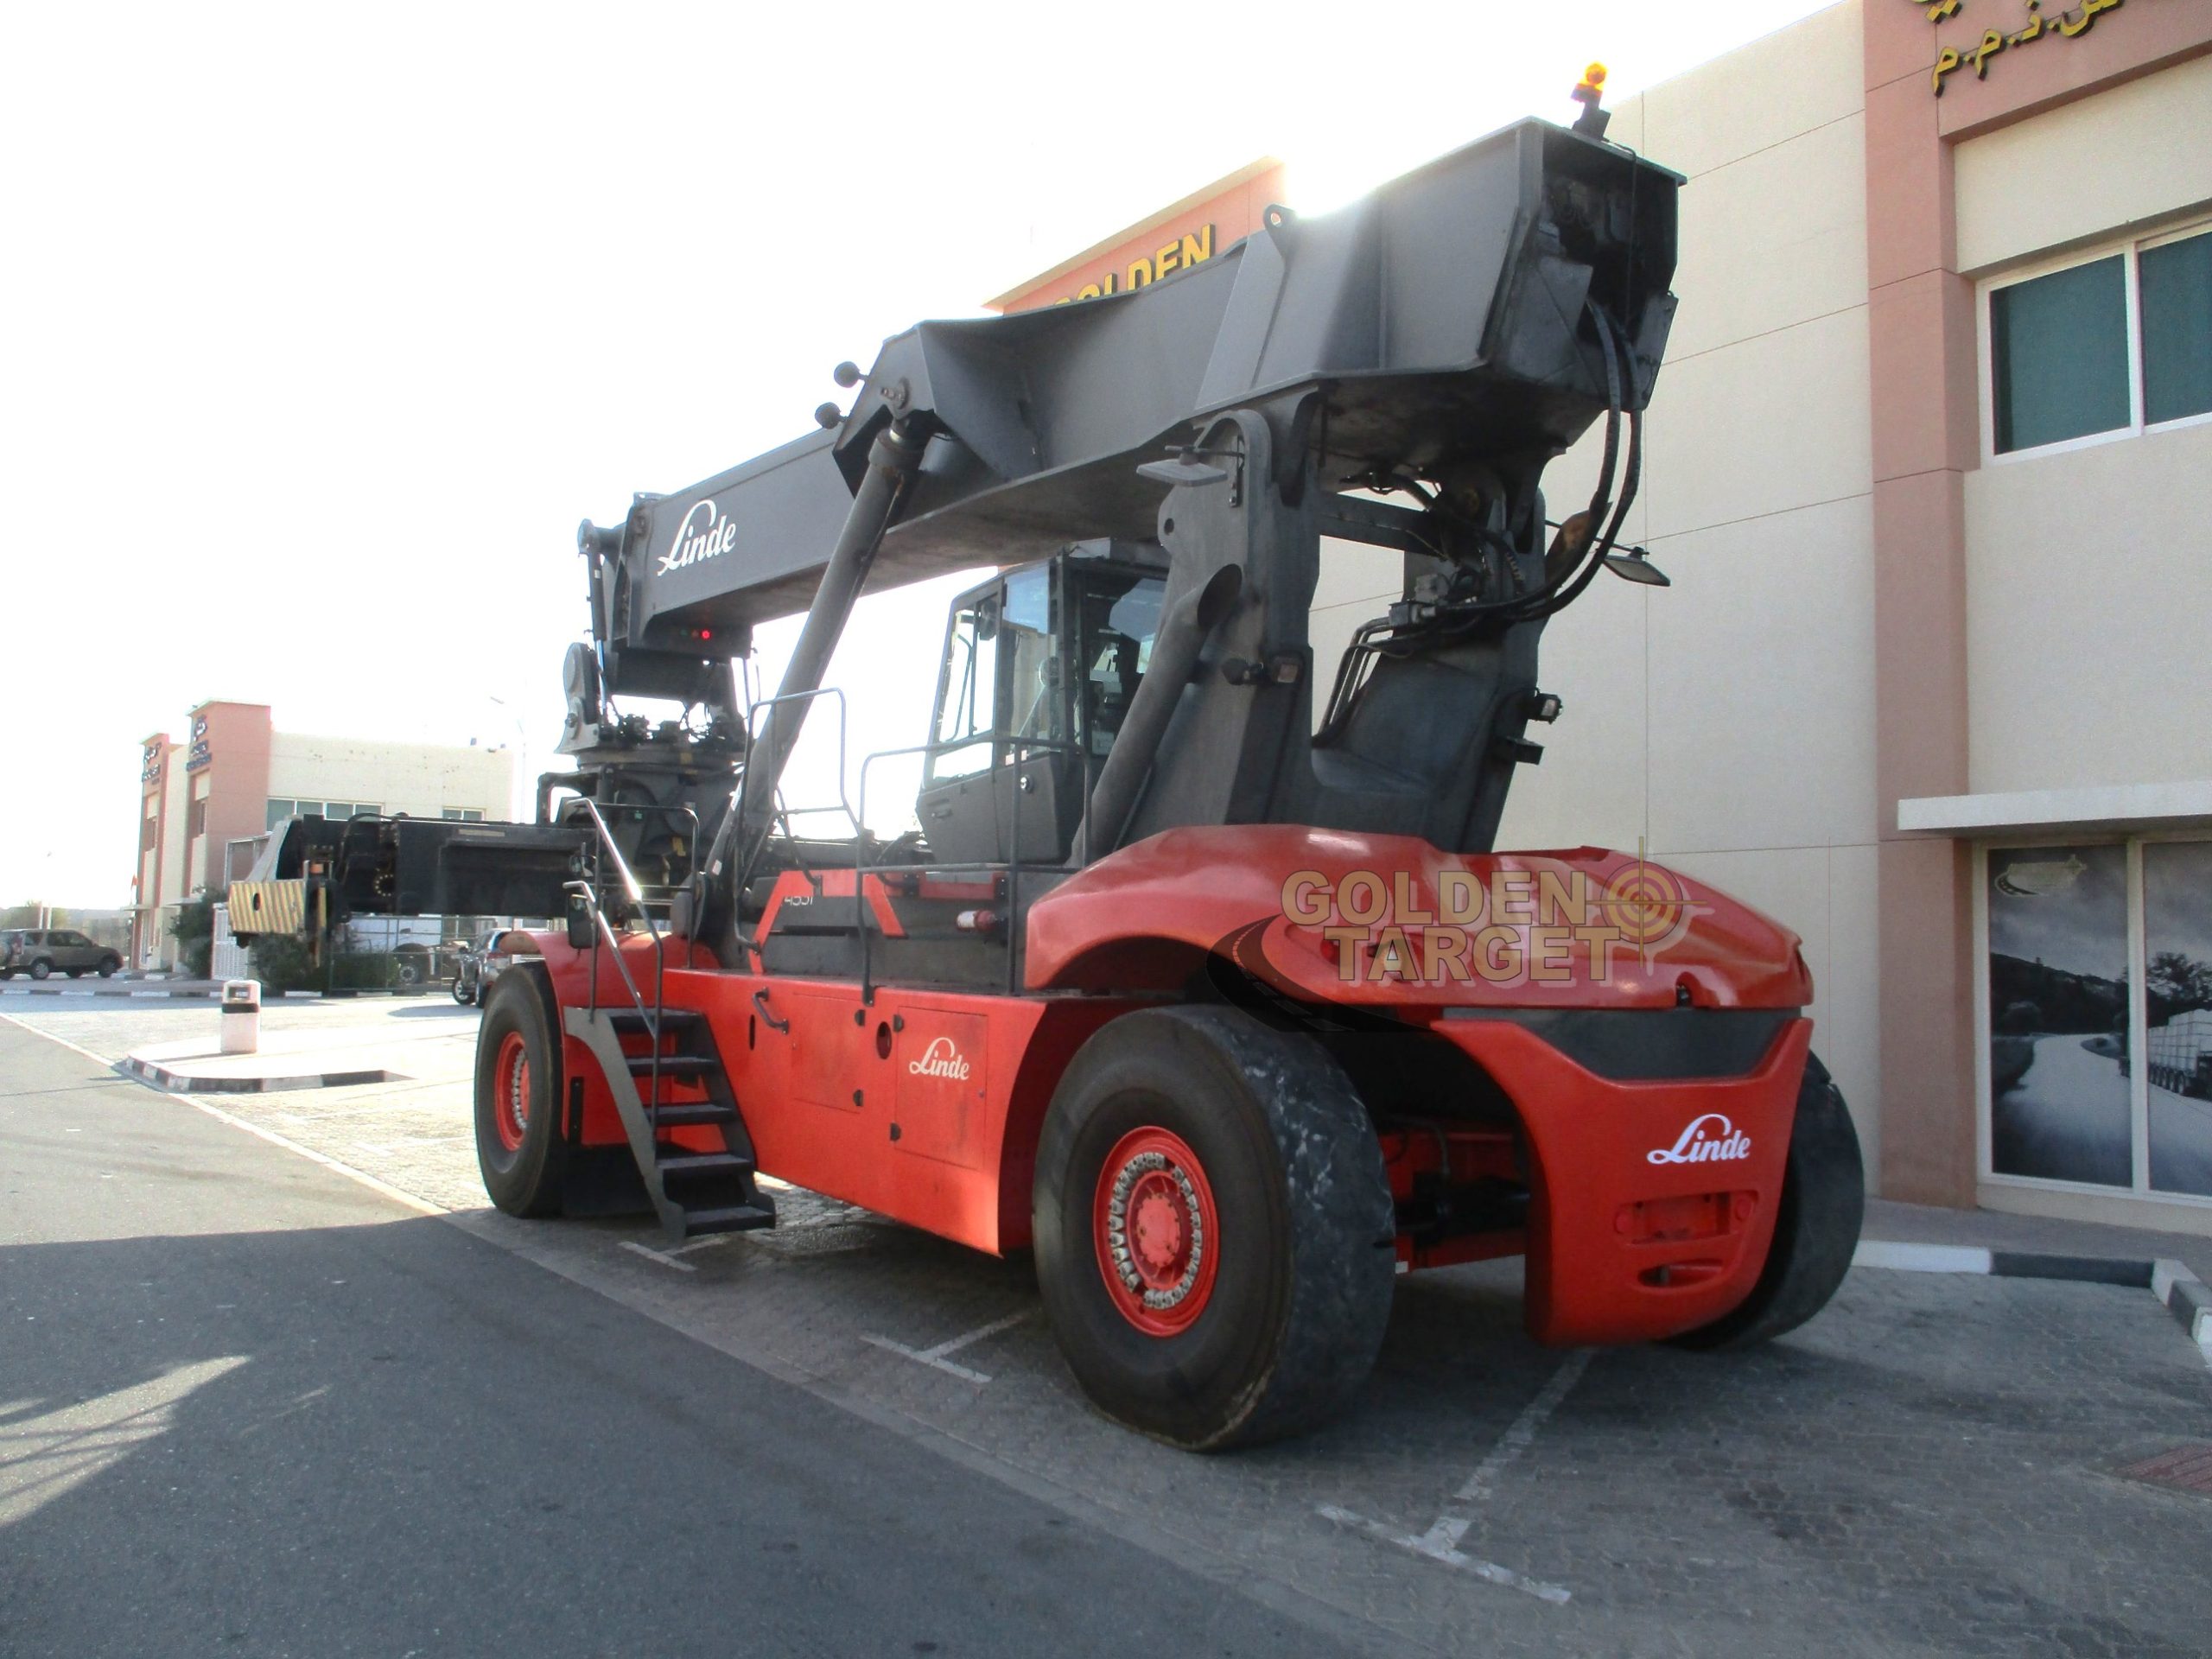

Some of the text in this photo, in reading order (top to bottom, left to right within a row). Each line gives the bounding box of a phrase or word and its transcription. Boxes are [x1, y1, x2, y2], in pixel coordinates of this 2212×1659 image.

[657, 499, 736, 576] Linde
[909, 1036, 969, 1080] Linde
[1646, 1113, 1751, 1165] Linde
